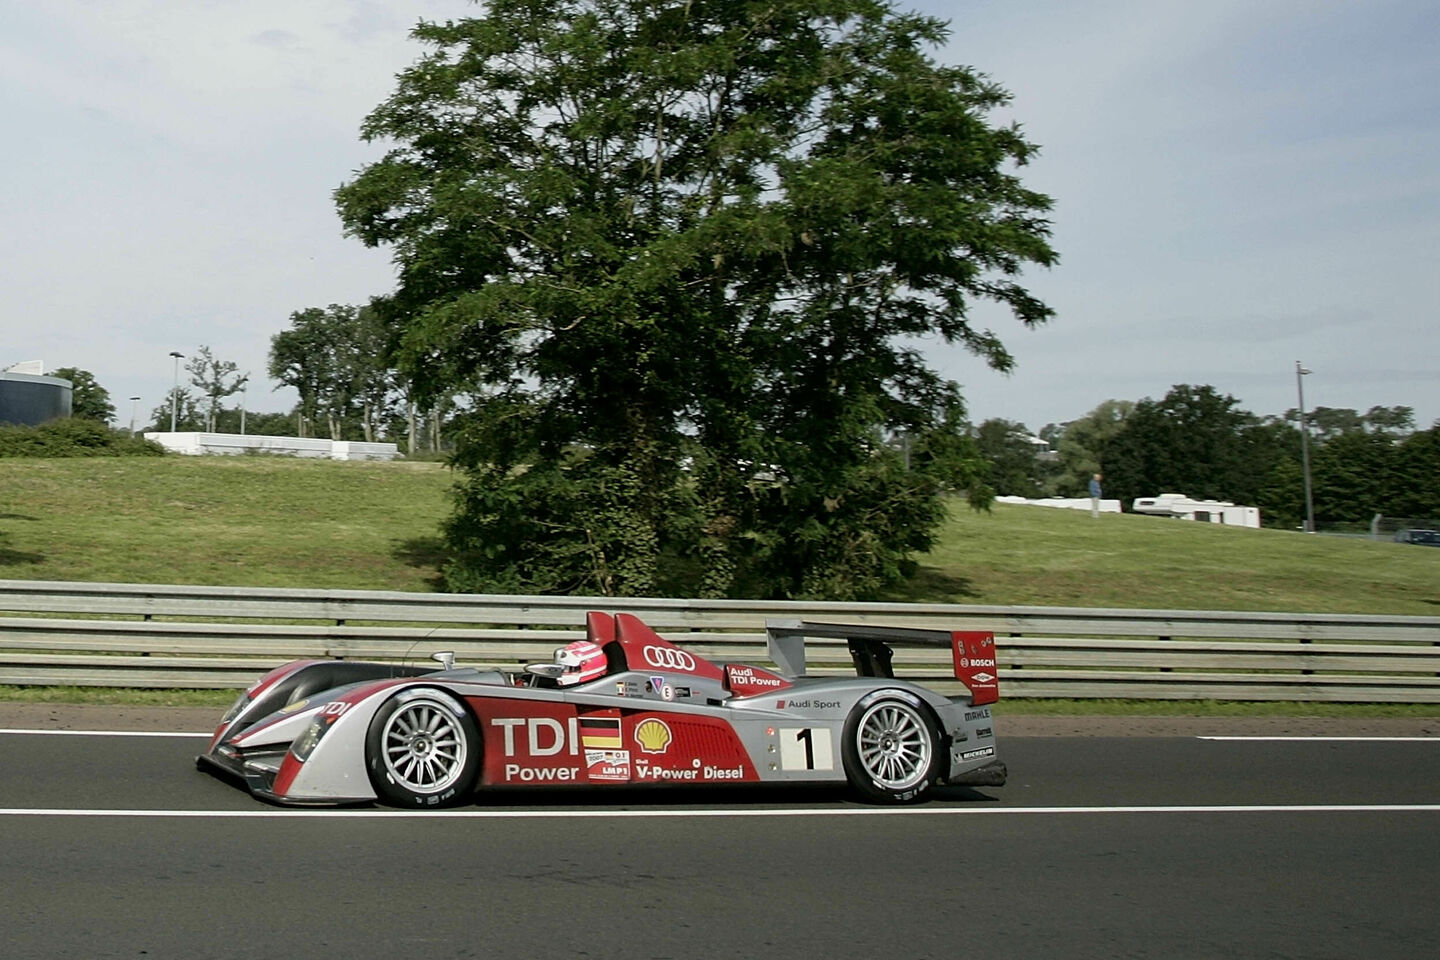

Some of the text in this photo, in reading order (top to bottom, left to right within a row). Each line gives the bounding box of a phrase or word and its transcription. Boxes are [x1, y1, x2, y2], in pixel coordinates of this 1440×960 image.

[970, 659, 995, 667] BOSCH
[730, 668, 753, 677] Audi
[731, 676, 780, 686] TDI Power
[664, 687, 670, 697] E
[320, 701, 352, 716] TDI
[788, 700, 841, 711] Audi Sport
[964, 709, 990, 721] MAHLE
[491, 717, 579, 757] TDI
[796, 728, 814, 770] 1
[963, 748, 993, 759] MICHELIN
[505, 764, 580, 781] Power
[602, 767, 628, 775] LMP1
[636, 764, 743, 779] V-Power Diesel
